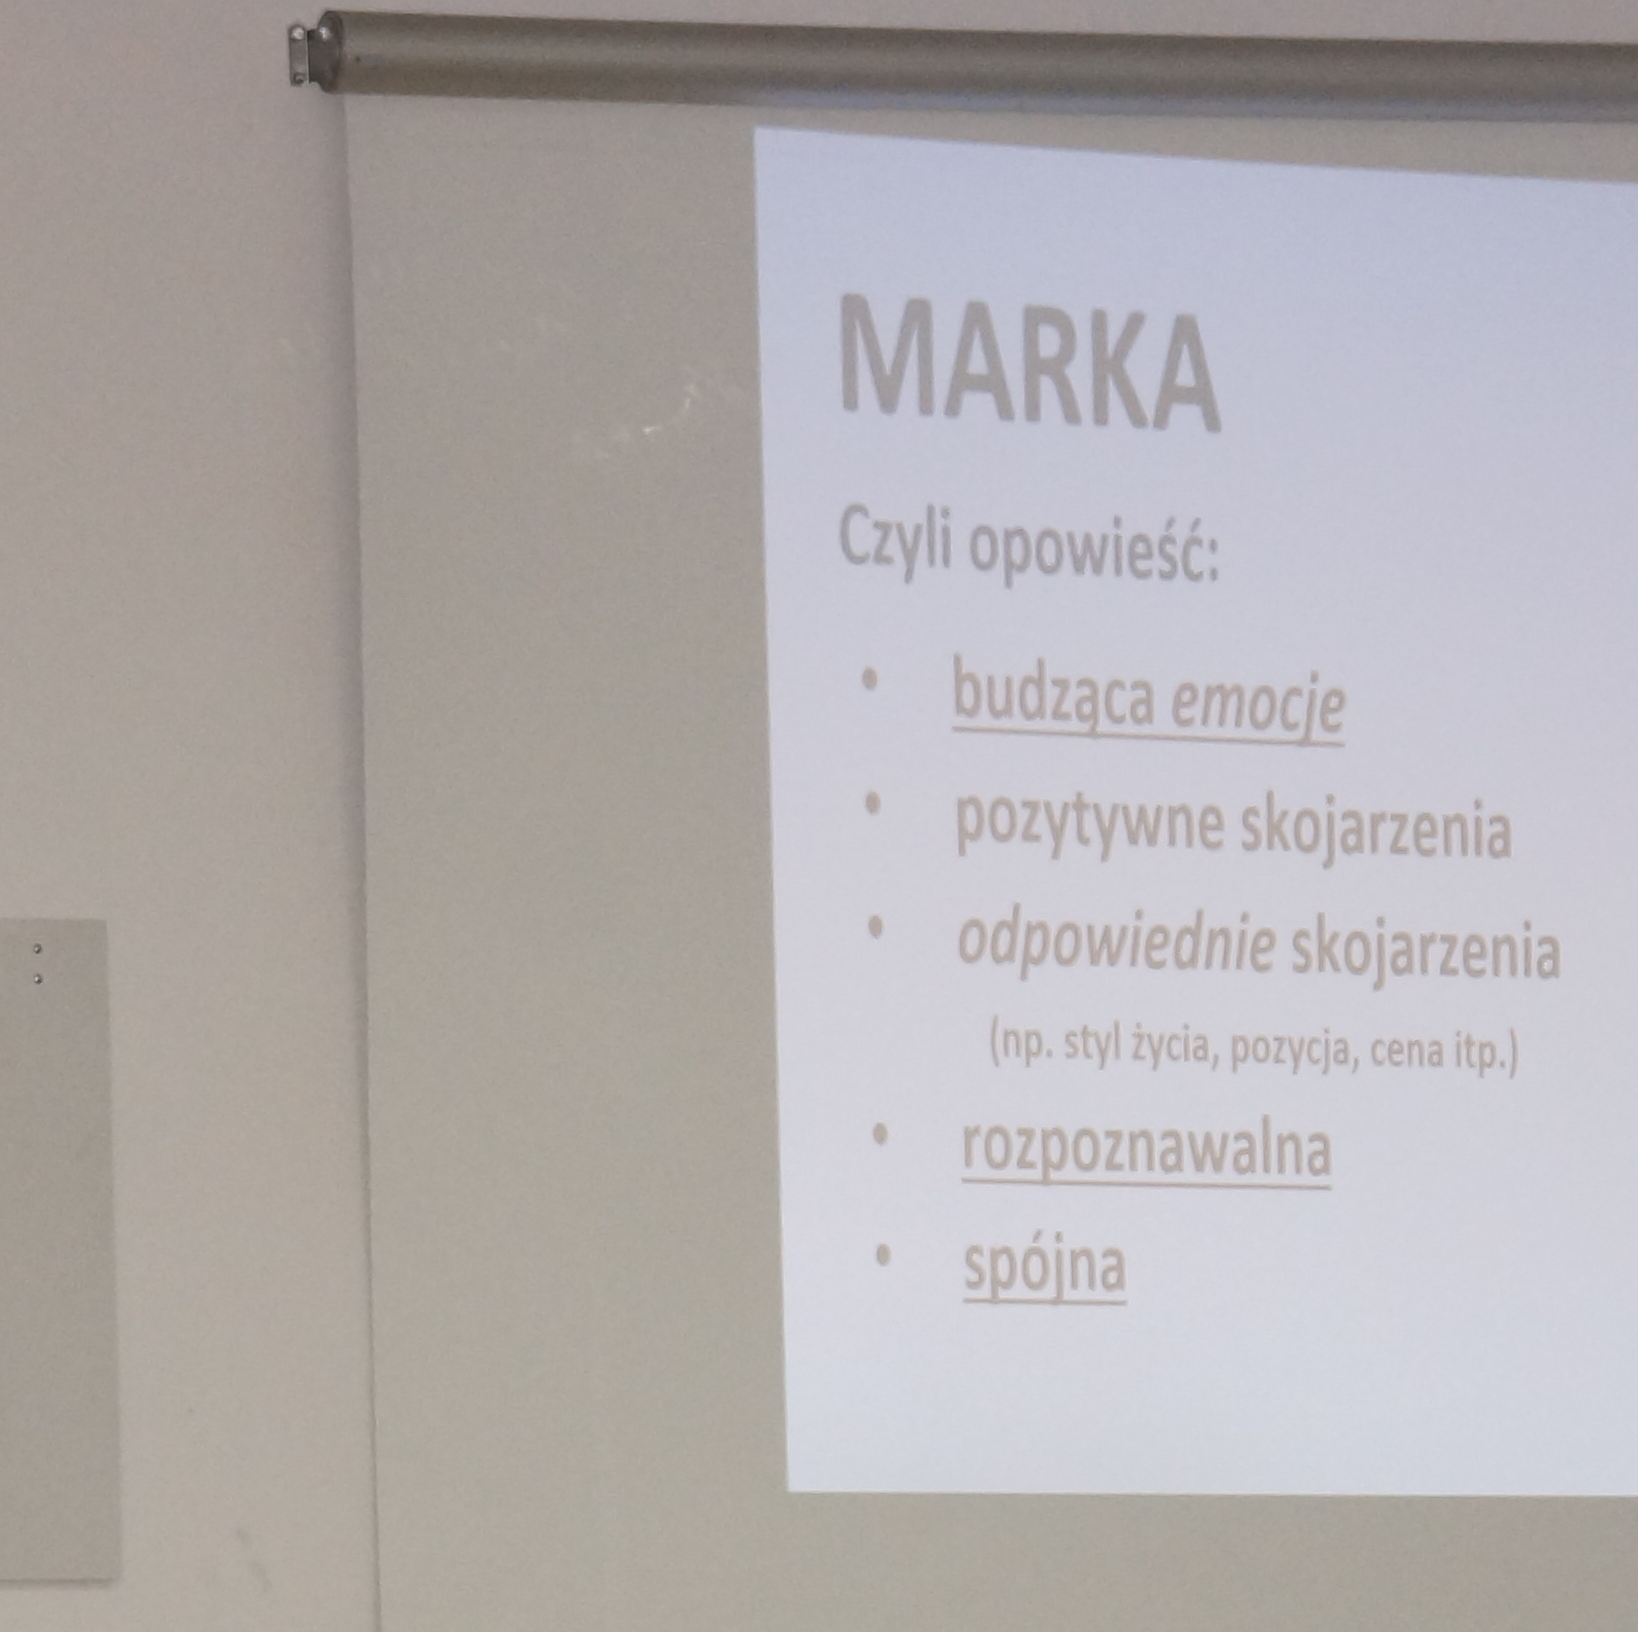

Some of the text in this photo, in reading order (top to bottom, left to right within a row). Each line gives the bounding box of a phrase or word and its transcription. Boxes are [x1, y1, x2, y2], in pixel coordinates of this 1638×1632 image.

[839, 292, 1223, 434] MARKA
[838, 502, 1220, 589] Czyli opowieść:
[952, 652, 1348, 746] budząca emocje
[956, 790, 1513, 870] pozytywne skojarzenia
[957, 901, 1562, 991] odpowiednie skojarzenia
[989, 1015, 1519, 1080] (np. styl życia, pozycja, cena itp.)
[961, 1114, 1333, 1186] rozpoznawalna
[962, 1229, 1128, 1303] spójna
